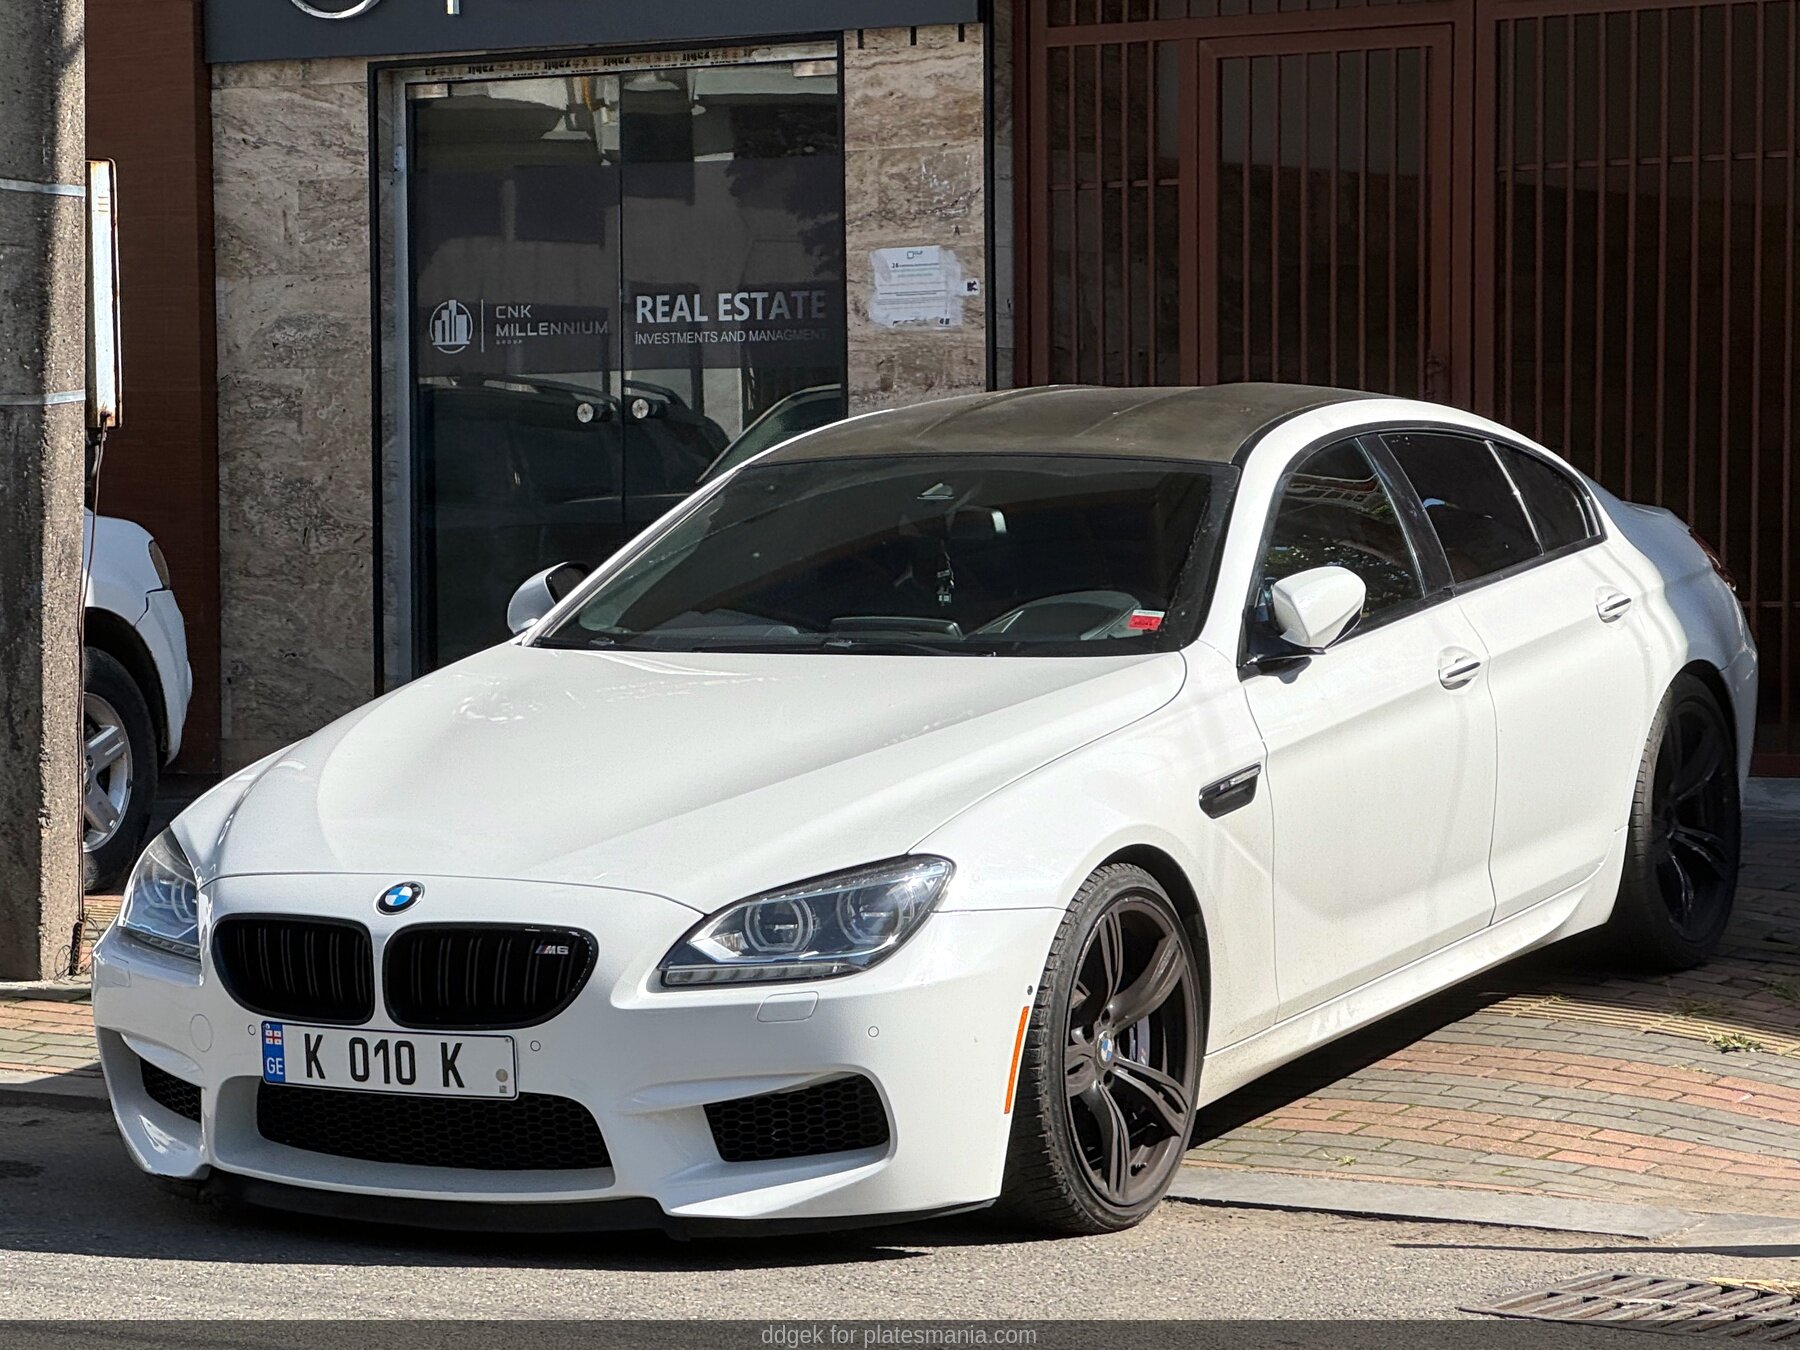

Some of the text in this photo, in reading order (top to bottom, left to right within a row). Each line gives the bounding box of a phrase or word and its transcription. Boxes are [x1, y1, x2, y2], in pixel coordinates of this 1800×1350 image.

[496, 304, 532, 319] CNK
[636, 289, 827, 324] REAL ESTATE
[496, 321, 608, 337] MILLENNIUM
[720, 329, 746, 343] AND
[545, 944, 569, 955] M6
[266, 1057, 284, 1075] GE
[304, 1033, 465, 1089] K 010 K
